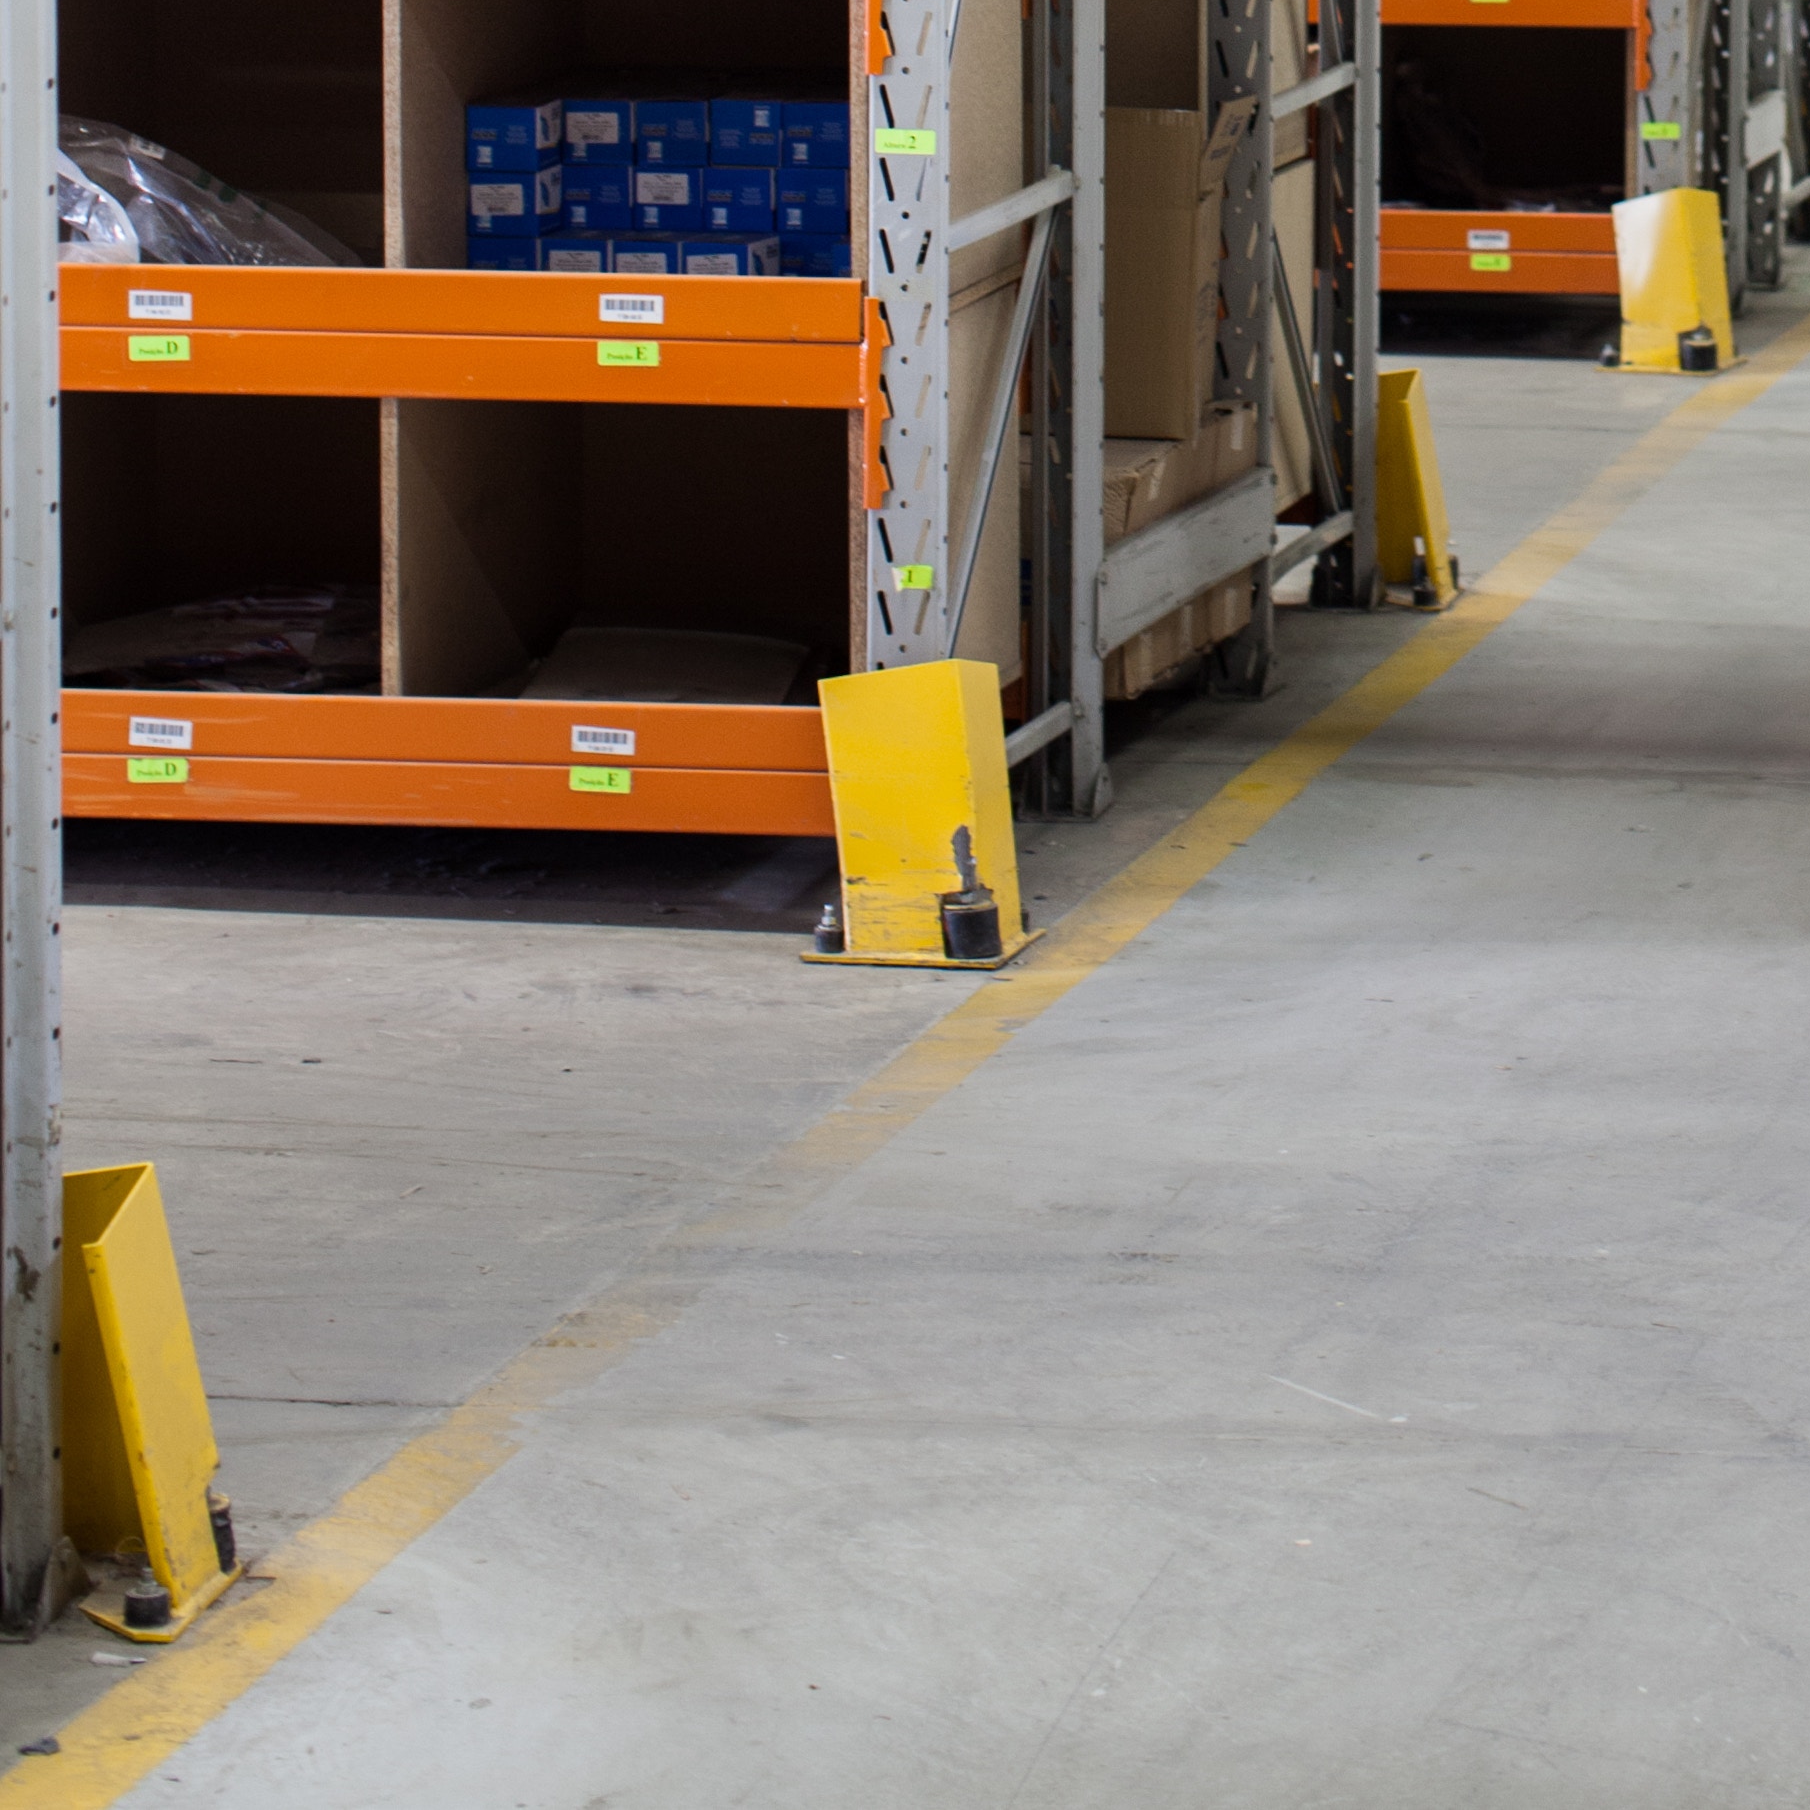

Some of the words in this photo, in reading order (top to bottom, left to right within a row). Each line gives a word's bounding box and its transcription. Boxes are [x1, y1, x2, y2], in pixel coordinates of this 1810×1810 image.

[908, 135, 917, 149] 2
[166, 341, 178, 354] D
[636, 346, 647, 360] E
[165, 762, 176, 776] D
[608, 772, 619, 787] E
